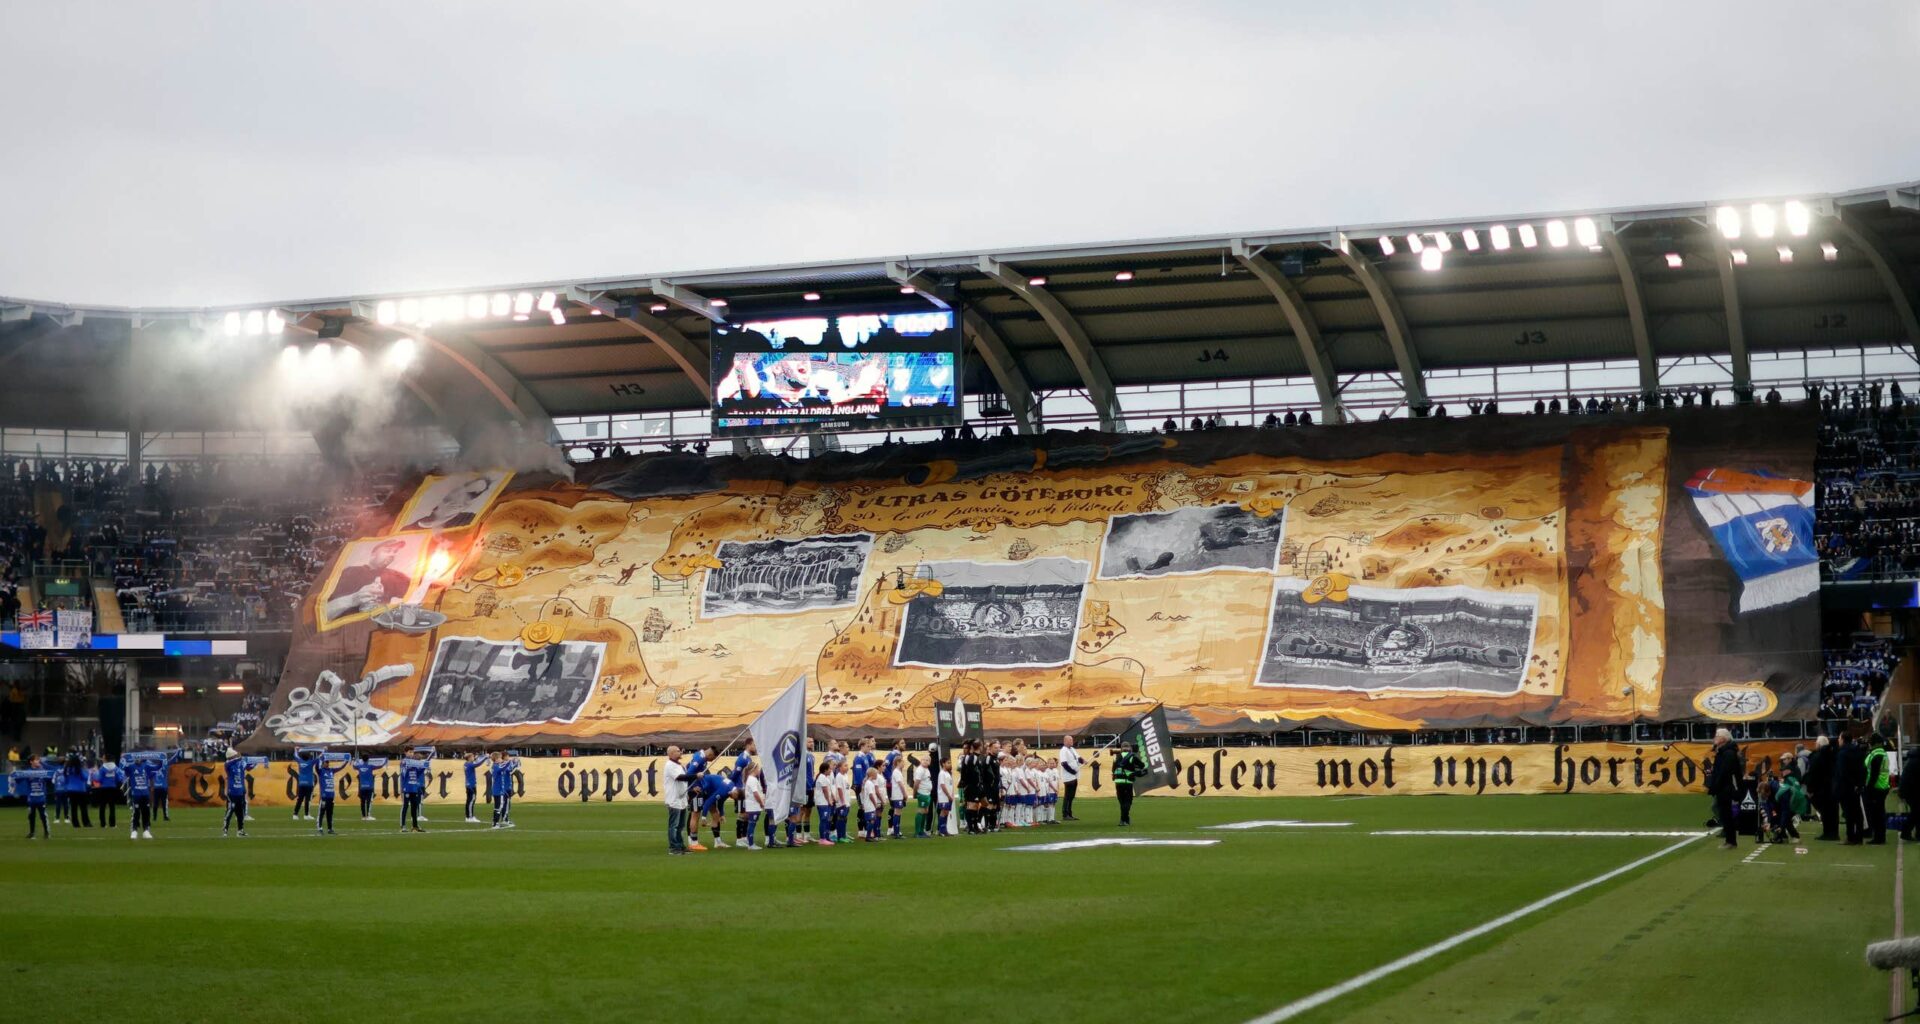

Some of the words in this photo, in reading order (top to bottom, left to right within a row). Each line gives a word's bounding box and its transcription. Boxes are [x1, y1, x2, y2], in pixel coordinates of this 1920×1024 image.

[1814, 315, 1848, 328] J2
[1514, 331, 1547, 345] J3
[1196, 349, 1230, 362] J4
[609, 383, 646, 396] H3
[820, 421, 850, 429] SAMSUNG
[857, 490, 968, 508] ULTRAS
[979, 484, 1134, 502] GÖTEBORG
[943, 504, 1020, 519] passion
[1025, 503, 1057, 516] och
[914, 615, 972, 632] 2005
[1020, 615, 1073, 631] 2015
[1141, 716, 1168, 773] UNIBET
[558, 759, 660, 802] öppet
[1315, 747, 1396, 789] mot
[1433, 755, 1515, 796] nya
